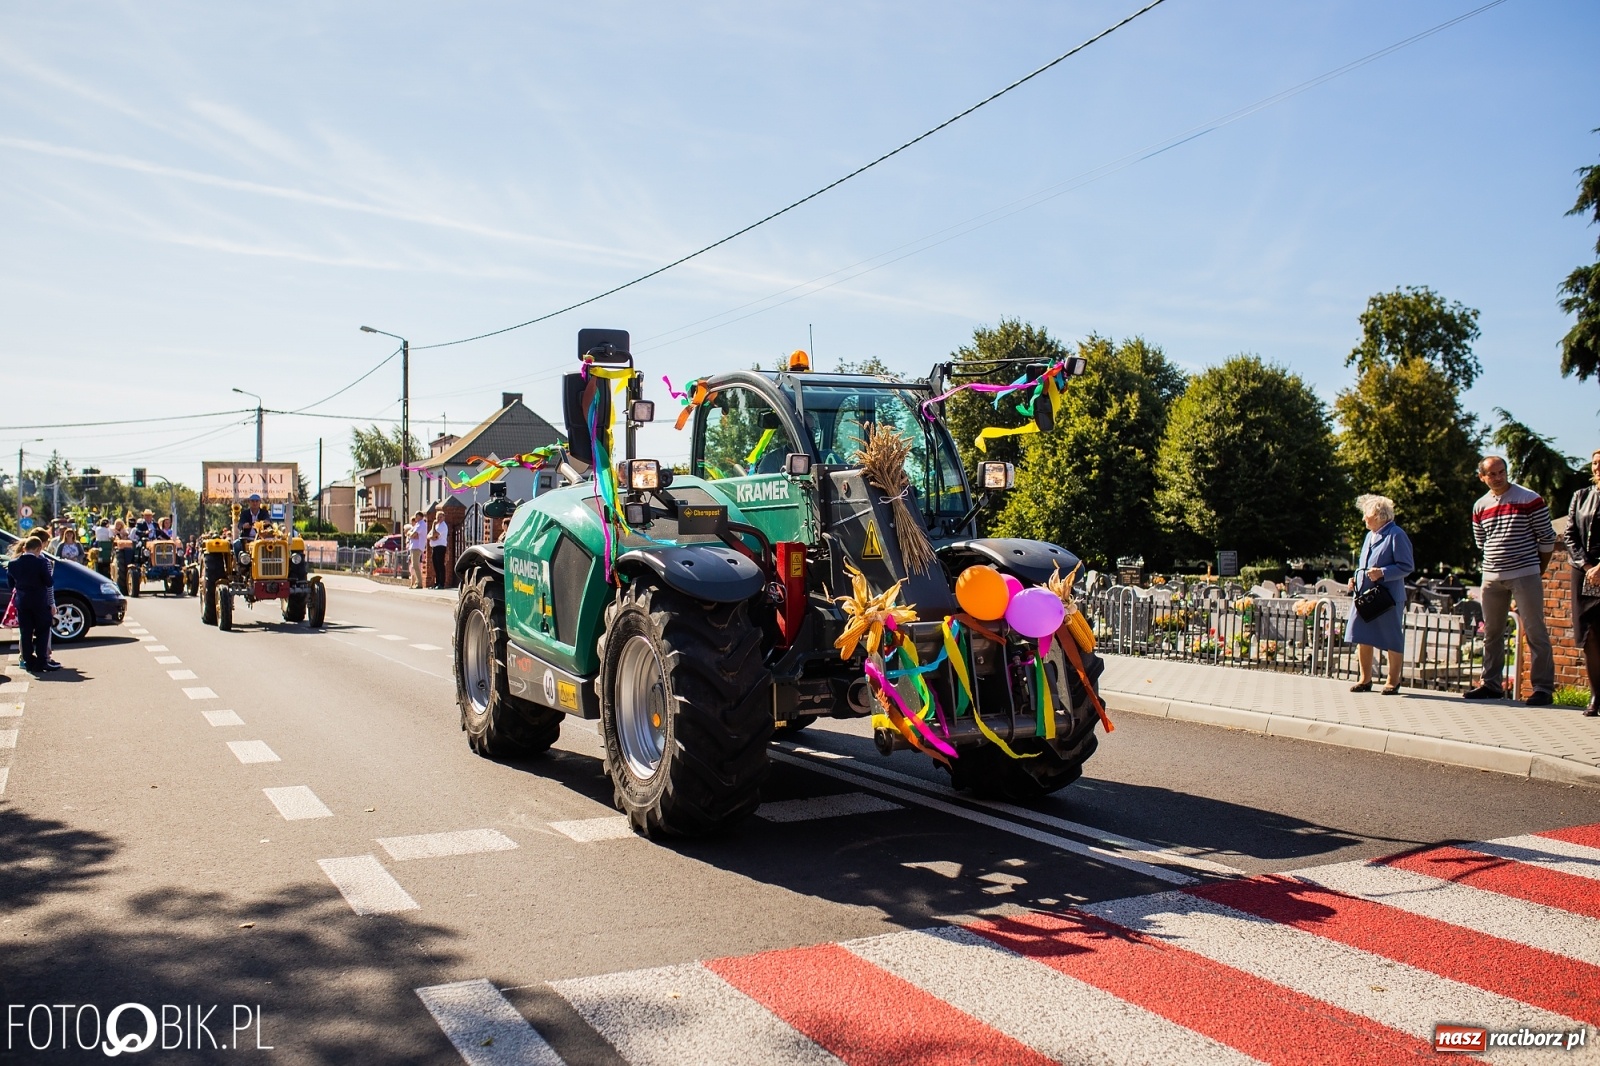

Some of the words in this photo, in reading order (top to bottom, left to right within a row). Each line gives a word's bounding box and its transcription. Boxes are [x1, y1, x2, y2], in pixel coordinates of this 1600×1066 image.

[217, 470, 284, 484] DOŻYNKI
[736, 480, 790, 503] KRAMER
[509, 556, 540, 580] KRAMER
